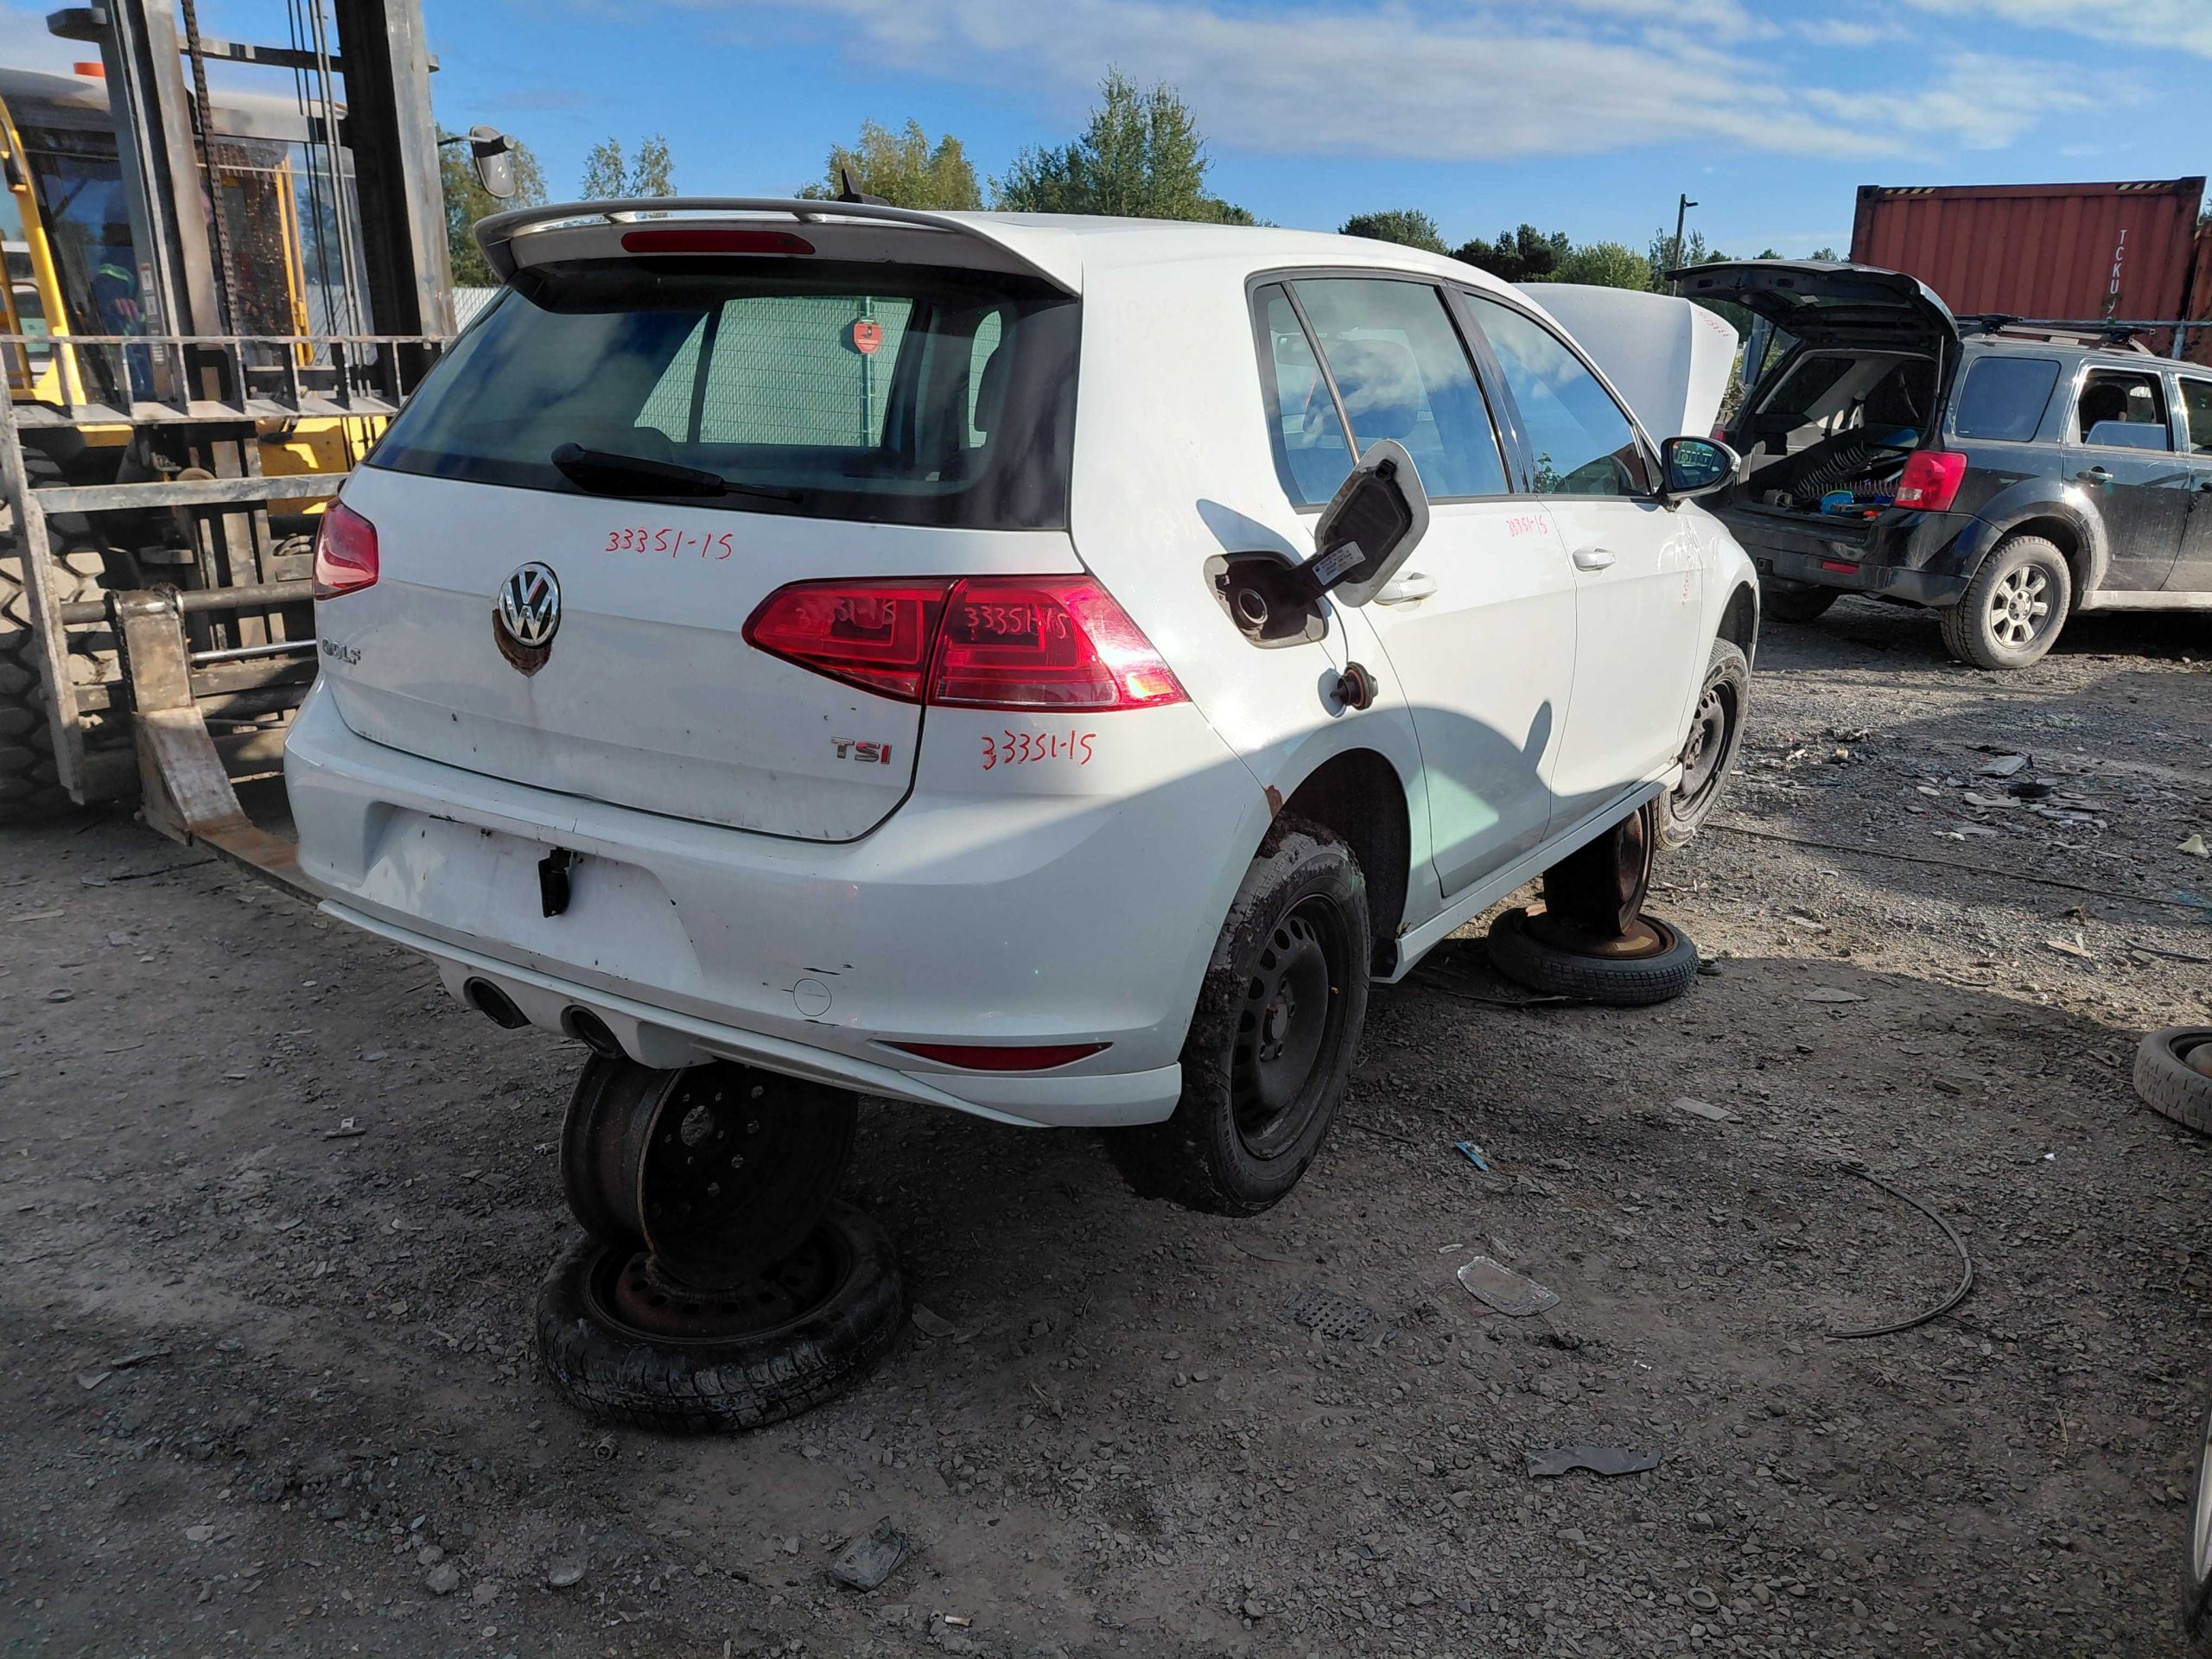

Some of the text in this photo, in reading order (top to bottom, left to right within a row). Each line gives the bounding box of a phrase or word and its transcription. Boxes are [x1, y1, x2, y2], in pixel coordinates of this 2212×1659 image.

[2109, 229, 2127, 294] TCKU
[605, 528, 734, 560] 33351-15
[830, 736, 893, 766] TSI
[982, 729, 1096, 771] 33351-15
